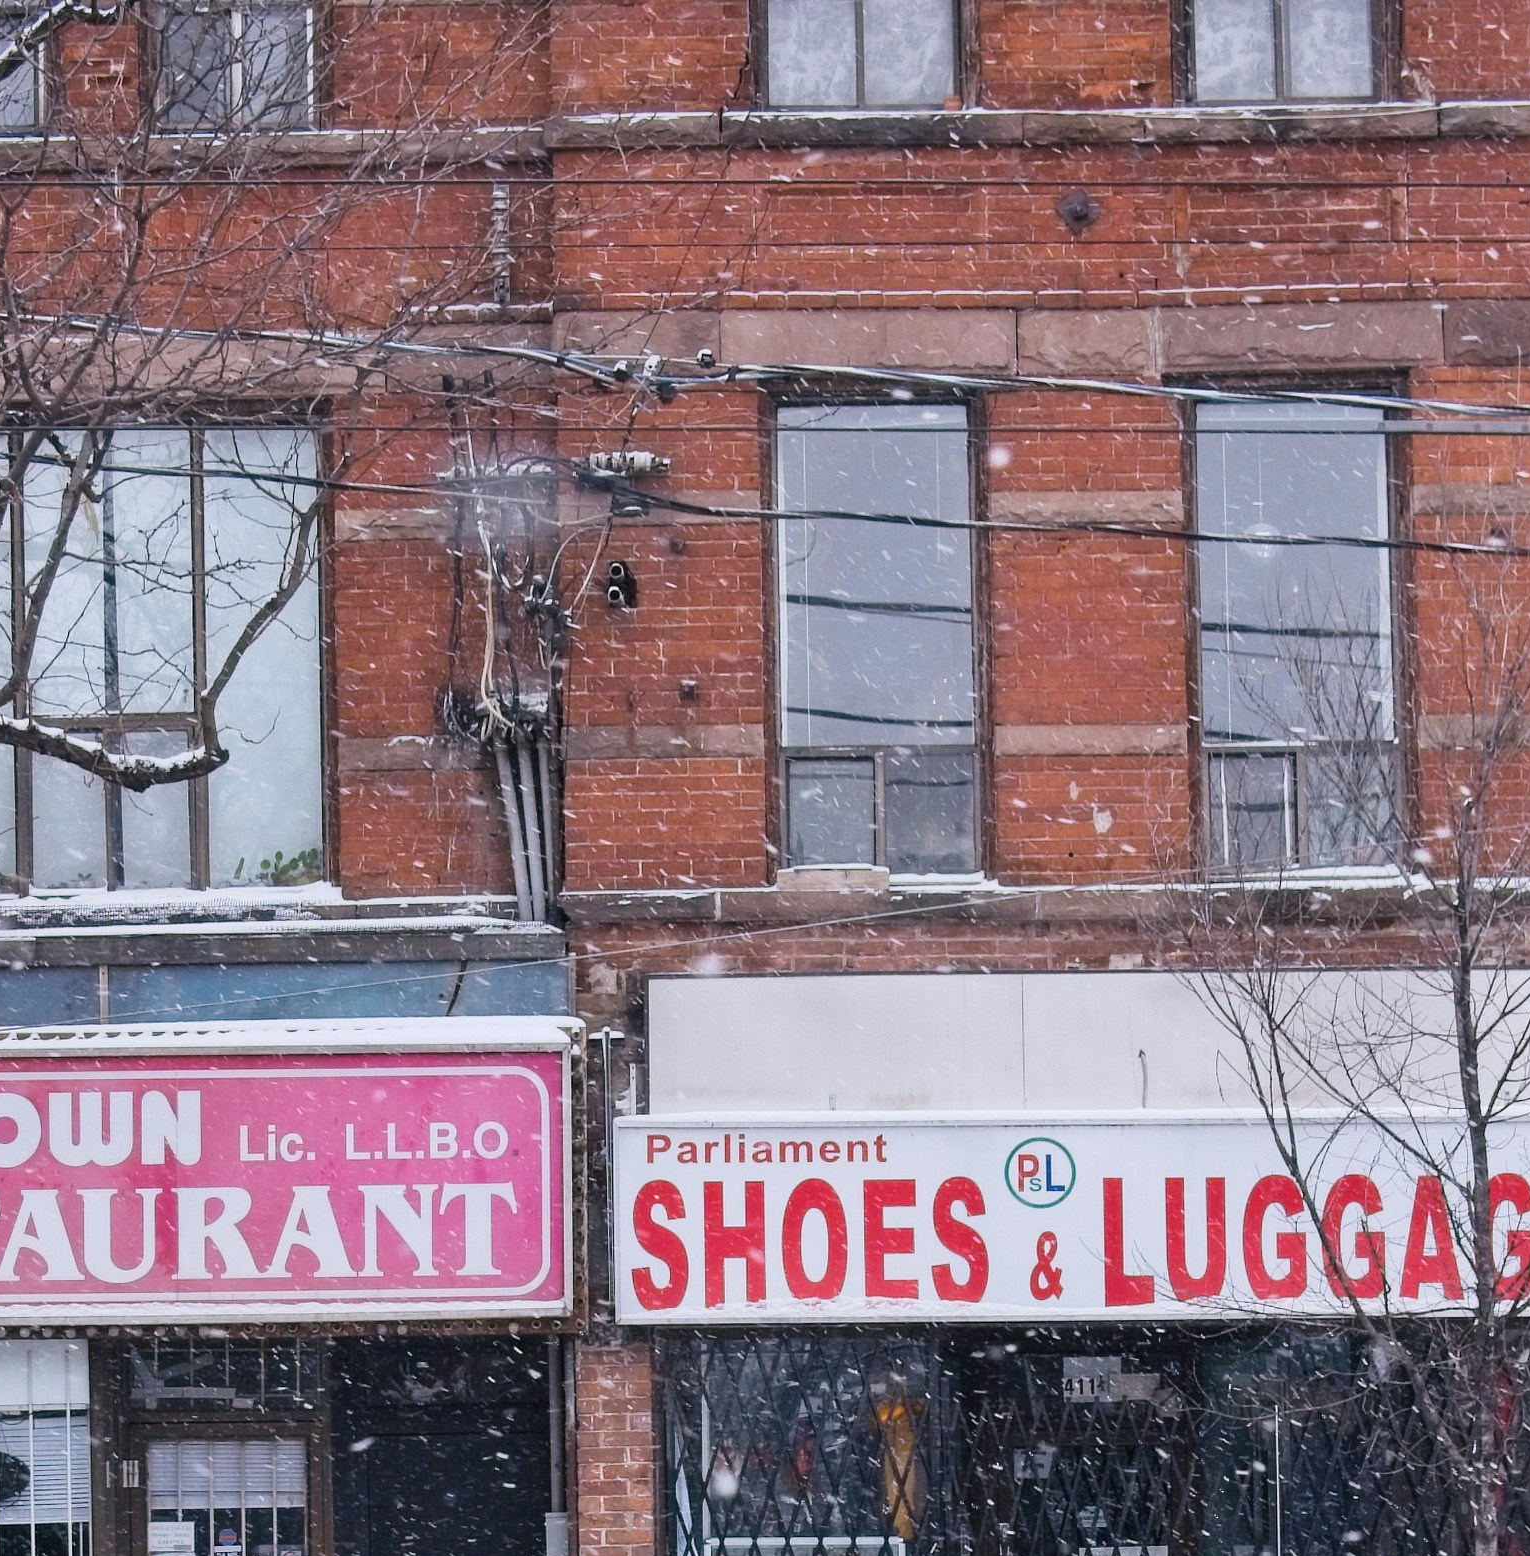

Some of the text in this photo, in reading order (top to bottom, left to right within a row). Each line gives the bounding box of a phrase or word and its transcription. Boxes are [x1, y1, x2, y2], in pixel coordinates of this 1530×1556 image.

[239, 1124, 316, 1161] Lic.
[646, 1133, 888, 1164] Parliament
[630, 1177, 989, 1311] SHOES
[1031, 1230, 1063, 1302] &
